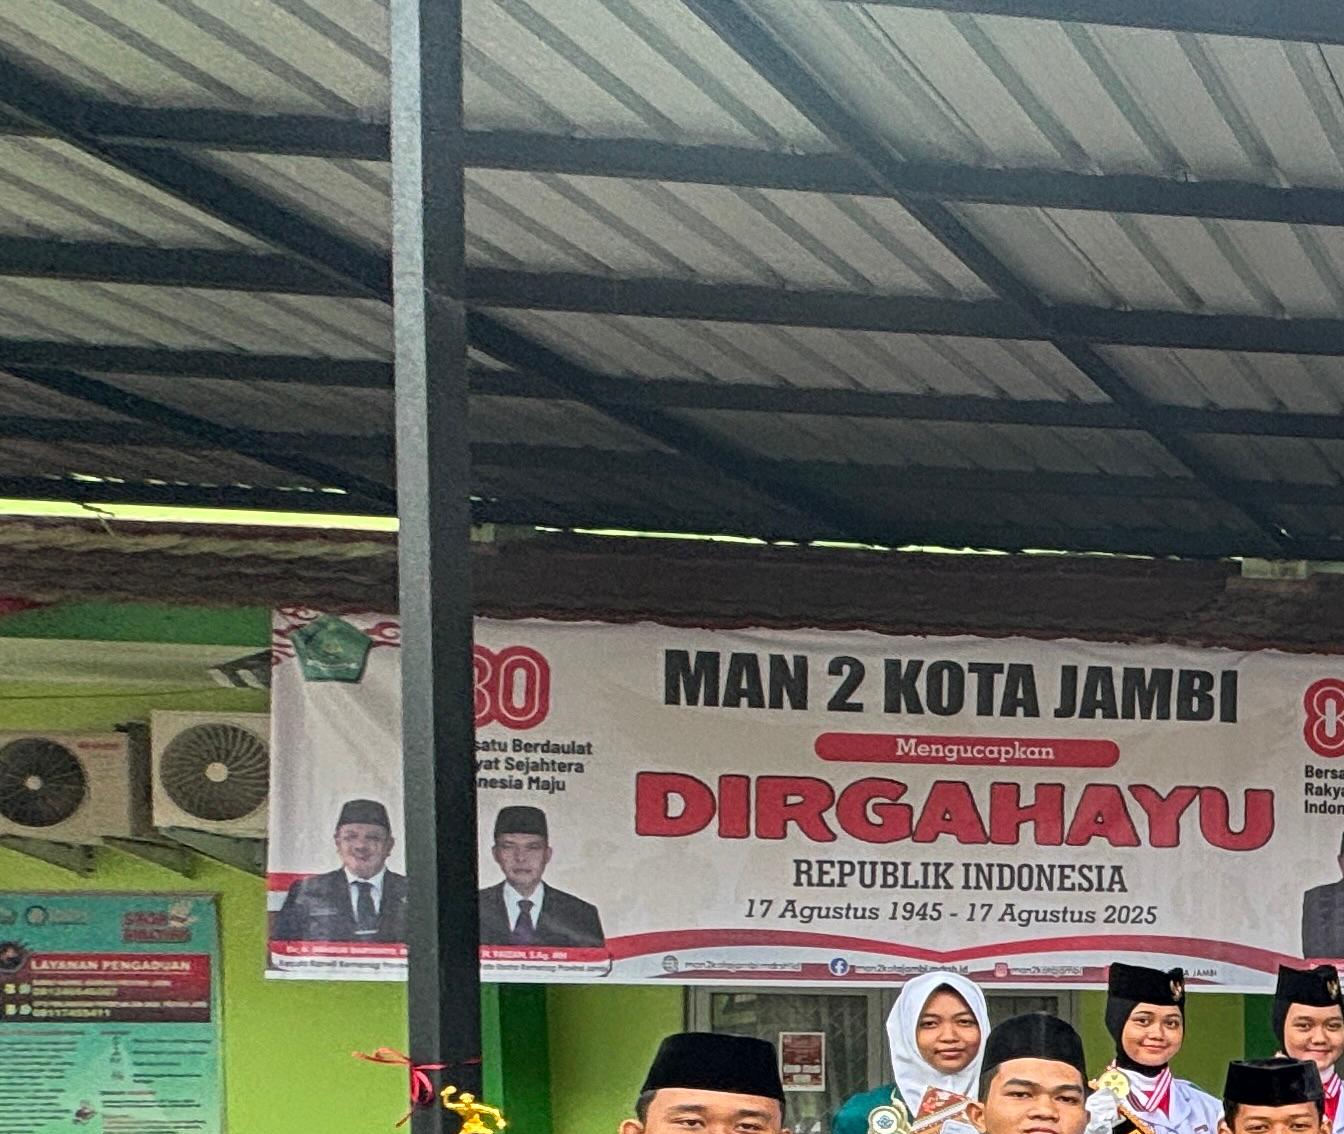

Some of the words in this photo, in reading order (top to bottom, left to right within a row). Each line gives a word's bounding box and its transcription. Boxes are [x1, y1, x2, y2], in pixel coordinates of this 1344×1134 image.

[664, 649, 809, 710] MAN
[827, 655, 866, 713] 2
[883, 658, 1041, 718] KOTA
[1054, 664, 1238, 724] JAMBI
[512, 739, 593, 755] Berdaulat
[895, 738, 1055, 763] Mengucapkan
[476, 757, 501, 772] yat
[504, 757, 585, 775] Sejahtera
[476, 775, 524, 790] nesia
[527, 775, 566, 795] Maju
[635, 771, 1275, 852] DIRGAHAYU
[792, 859, 955, 890] REPUBLIK
[961, 862, 1129, 893] INDONESIA
[744, 899, 774, 918] 17
[778, 900, 880, 924] Agustus
[888, 901, 944, 921] 1945
[966, 902, 993, 923] 17
[998, 903, 1097, 928] Agustus
[1103, 905, 1158, 925] 2025
[101, 960, 191, 971] PENGADUAN
